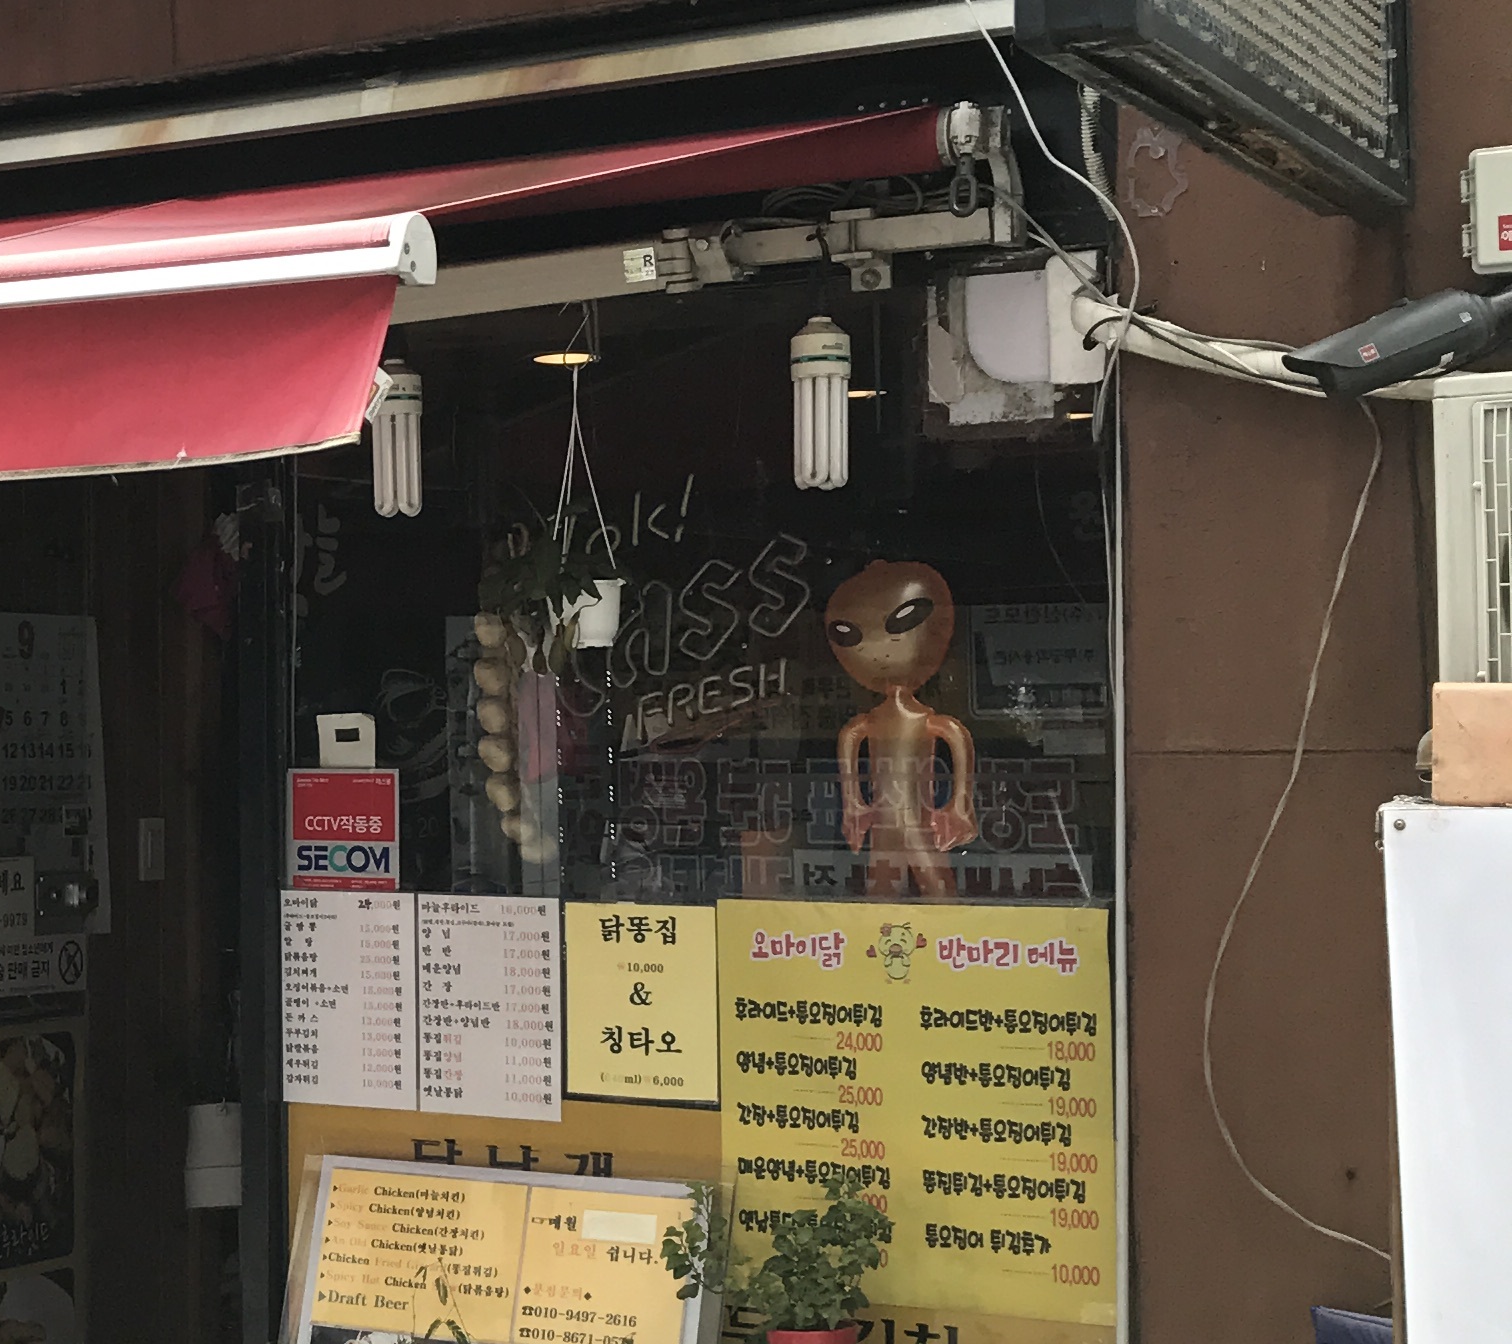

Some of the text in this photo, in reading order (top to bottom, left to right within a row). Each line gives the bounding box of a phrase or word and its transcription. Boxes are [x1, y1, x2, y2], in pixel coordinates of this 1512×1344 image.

[636, 657, 788, 738] FRESH
[305, 815, 383, 833] CCTV작동중
[297, 845, 390, 873] SECOM
[599, 914, 677, 945] 닭똥집
[752, 932, 1078, 972] 오마이닭 반마리 메뉴
[31, 960, 49, 978] 금지
[629, 981, 652, 1006] &
[600, 1025, 682, 1056] 칭타오
[836, 1031, 883, 1053] 24,000
[1046, 1040, 1096, 1062] 18,000
[838, 1086, 883, 1106] 25,000
[1047, 1096, 1097, 1118] 19,000
[840, 1138, 886, 1160] 25,000
[1048, 1152, 1098, 1174] 19,000
[1049, 1208, 1099, 1230] 19,000
[925, 1224, 1052, 1255] 통오징어 튀김추가
[328, 1252, 369, 1266] Chicken
[553, 1240, 658, 1265] 일요일 쉽니다.
[384, 1277, 427, 1290] Chicken
[1051, 1263, 1100, 1286] 10,000
[328, 1290, 409, 1310] Draft Beer
[533, 1307, 637, 1328] 010-9497-2616
